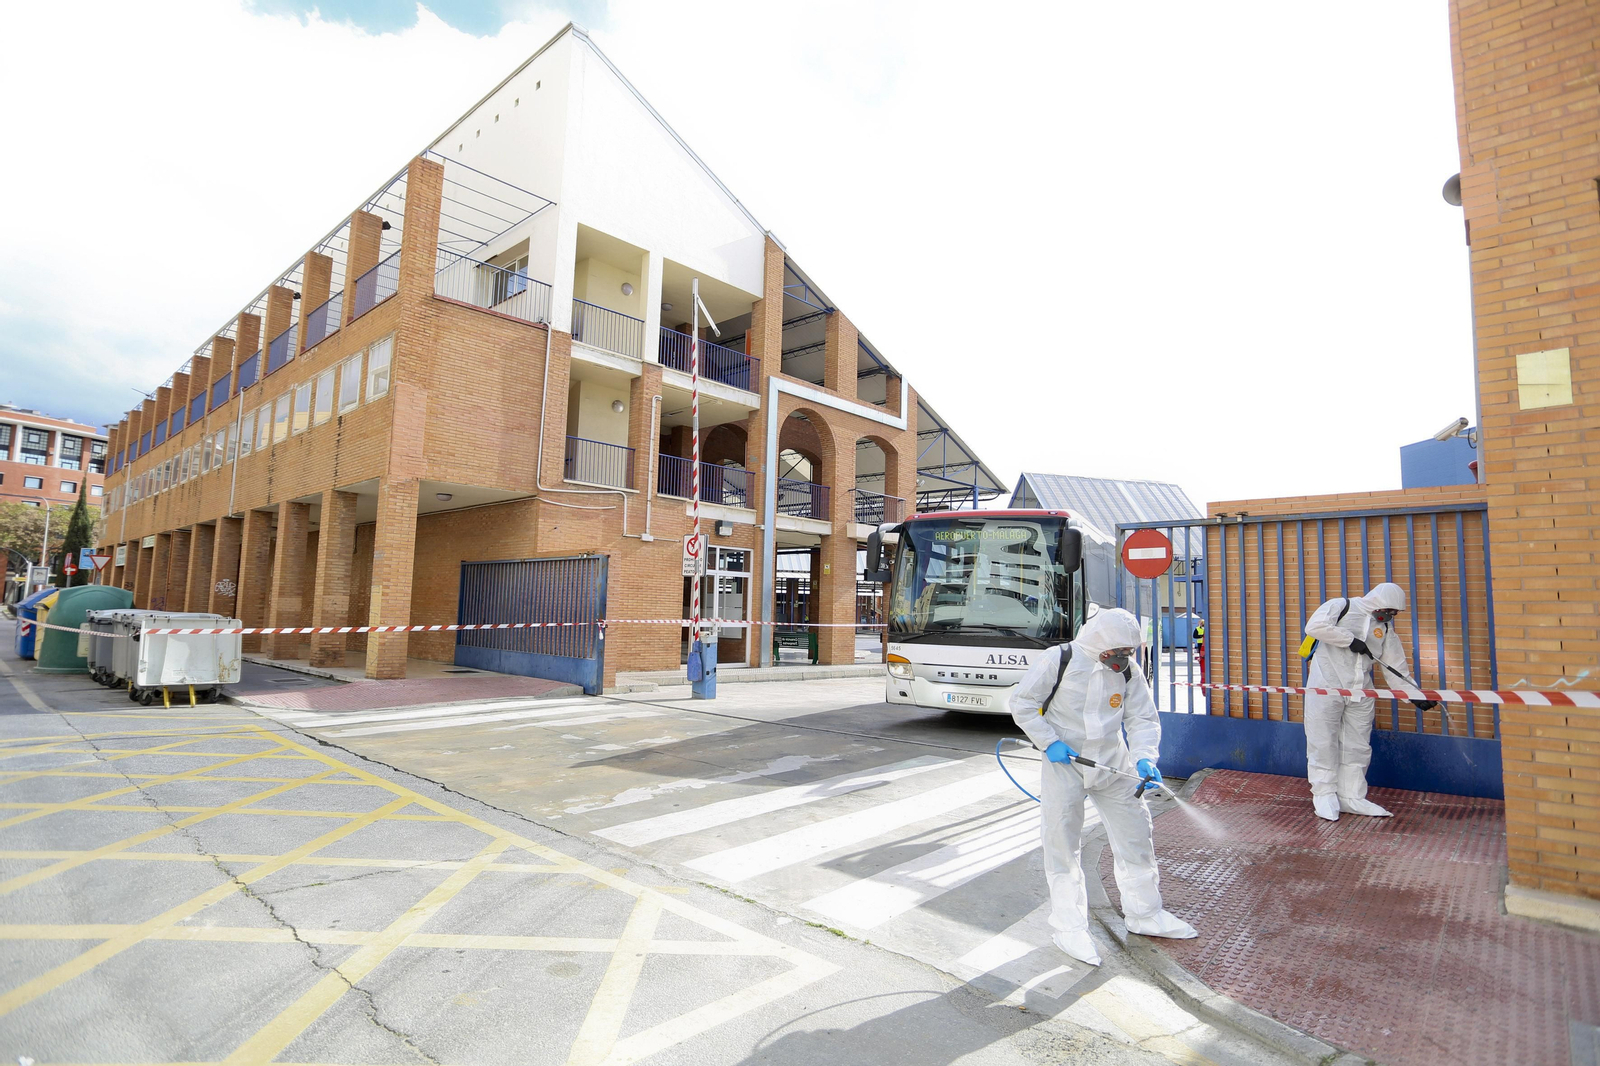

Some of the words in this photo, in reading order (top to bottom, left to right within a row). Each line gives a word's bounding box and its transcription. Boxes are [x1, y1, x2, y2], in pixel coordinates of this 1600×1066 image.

[985, 654, 1029, 665] ALSA
[937, 671, 998, 680] SETRA
[951, 693, 968, 703] 8127
[971, 697, 985, 705] FVL
